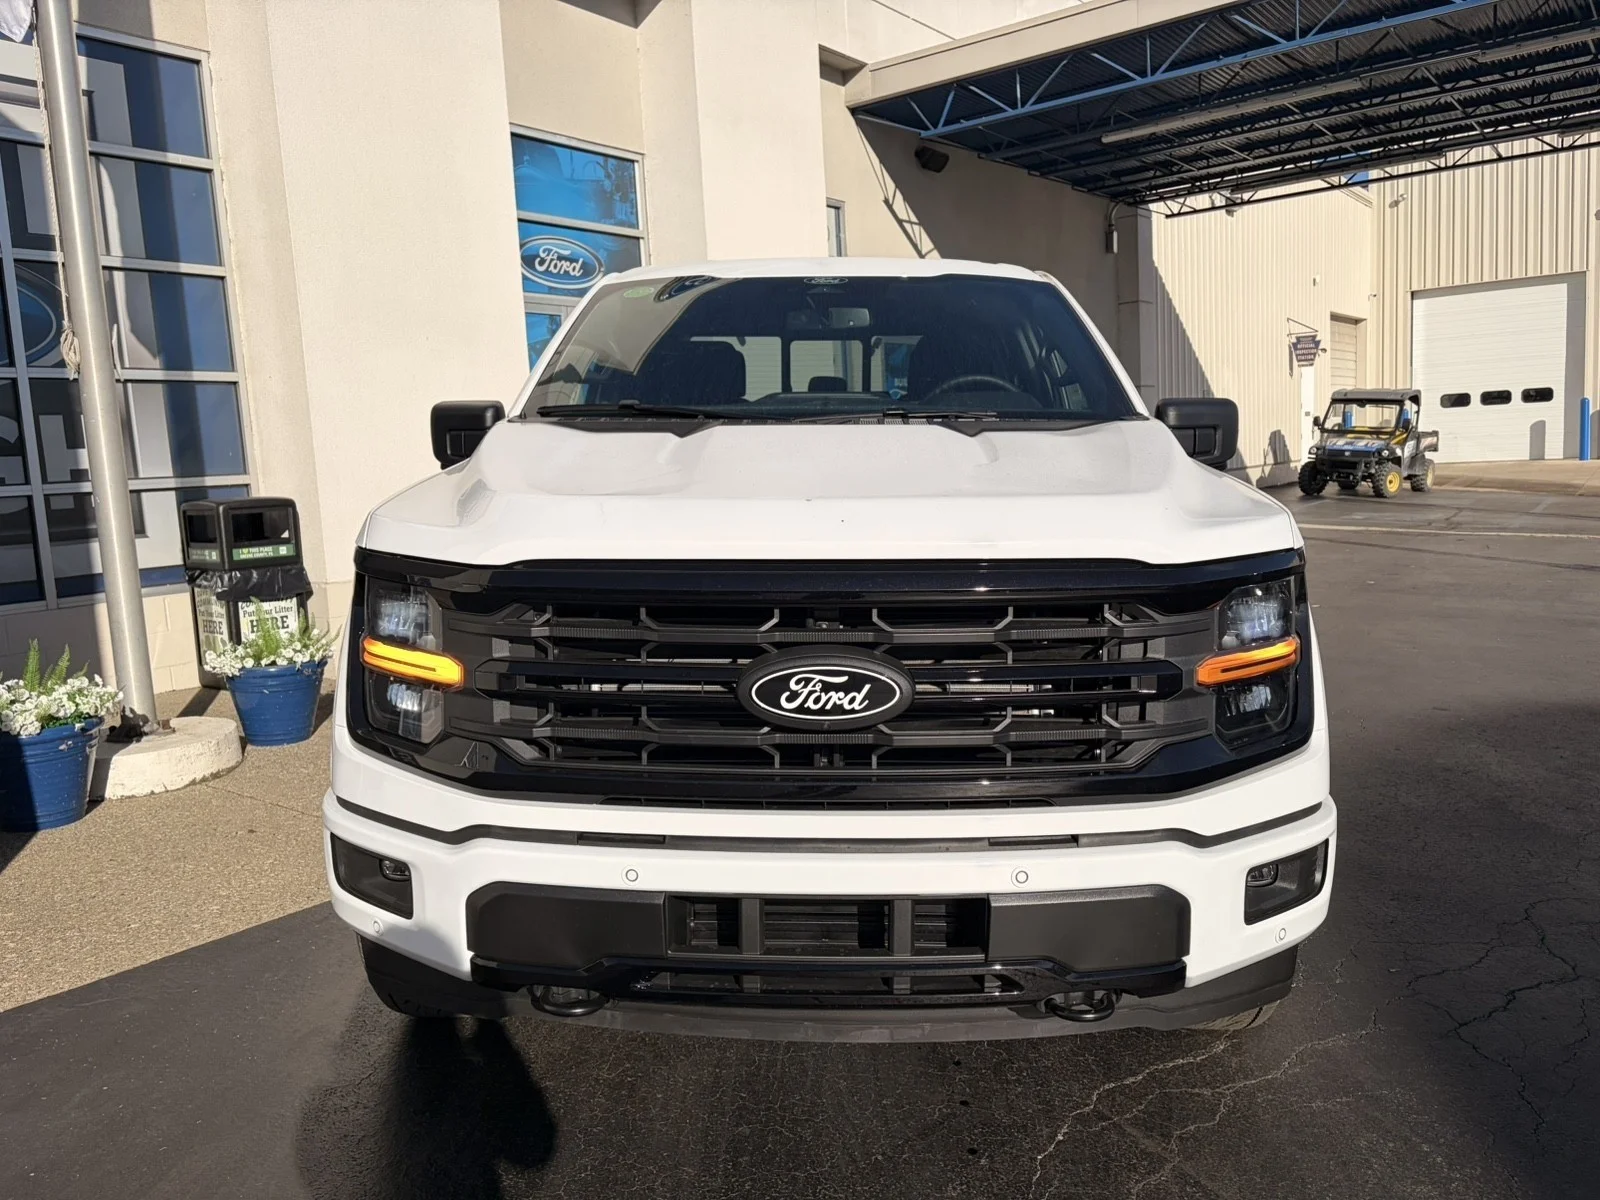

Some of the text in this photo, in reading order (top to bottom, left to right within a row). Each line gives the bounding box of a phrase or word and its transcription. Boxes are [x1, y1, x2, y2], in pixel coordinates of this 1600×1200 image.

[534, 245, 584, 277] Ford
[242, 610, 256, 618] Put
[274, 605, 293, 614] Litter
[203, 620, 223, 635] HERE
[250, 615, 289, 633] HRE
[779, 673, 872, 711] Ford
